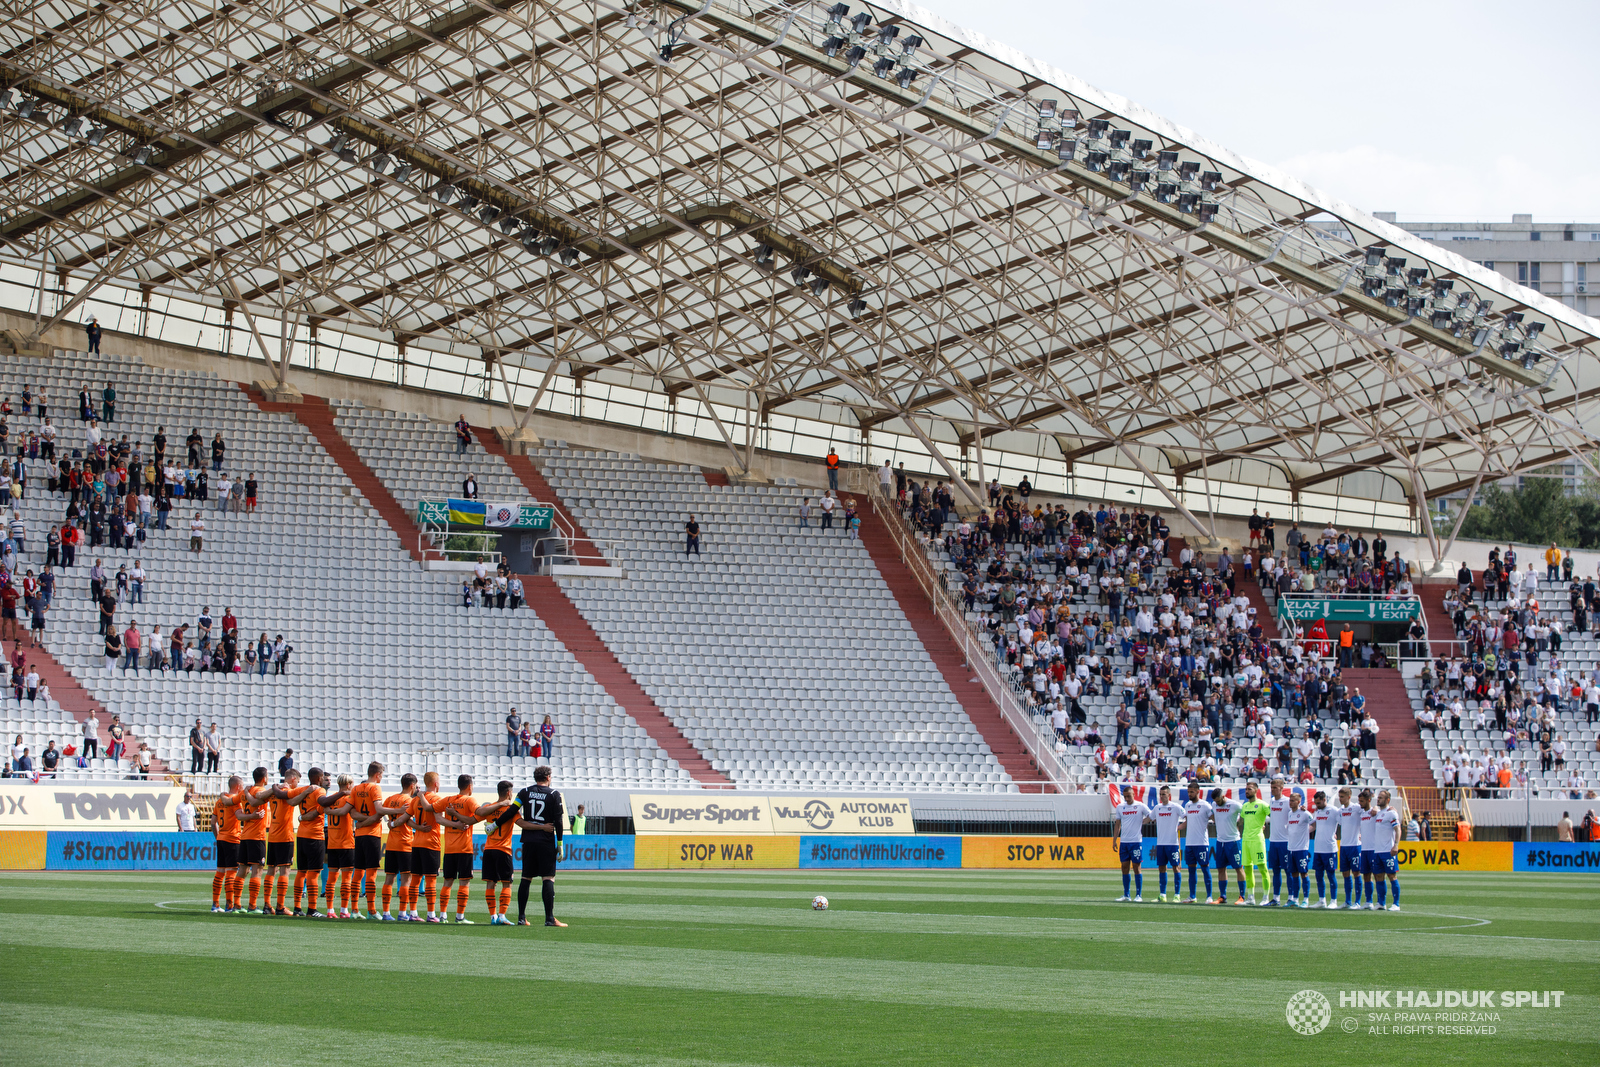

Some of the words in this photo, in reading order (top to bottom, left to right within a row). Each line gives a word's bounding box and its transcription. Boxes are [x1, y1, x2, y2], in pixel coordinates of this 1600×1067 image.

[423, 503, 449, 512] IZLA
[519, 508, 549, 518] ZLAZ
[518, 517, 544, 526] EXIT
[1287, 609, 1316, 618] EXIT
[1378, 602, 1415, 611] IZLAZ
[1382, 610, 1411, 619] EXIT
[54, 792, 171, 820] TOMMY
[360, 800, 370, 816] 4
[529, 799, 546, 821] 12
[641, 802, 761, 824] SuperSport
[840, 802, 908, 814] AUTOMAT
[219, 809, 225, 828] 3
[417, 807, 423, 825] 7
[858, 816, 894, 827] KLUB
[63, 840, 217, 861] #StandWithUkrai
[680, 843, 716, 862] STOP
[721, 844, 754, 861] WAR
[811, 843, 945, 861] #StandWithUkraine
[1007, 845, 1045, 861] STOP
[1049, 845, 1085, 861] WAR
[1397, 849, 1417, 865] OP
[1423, 849, 1460, 865] WAR
